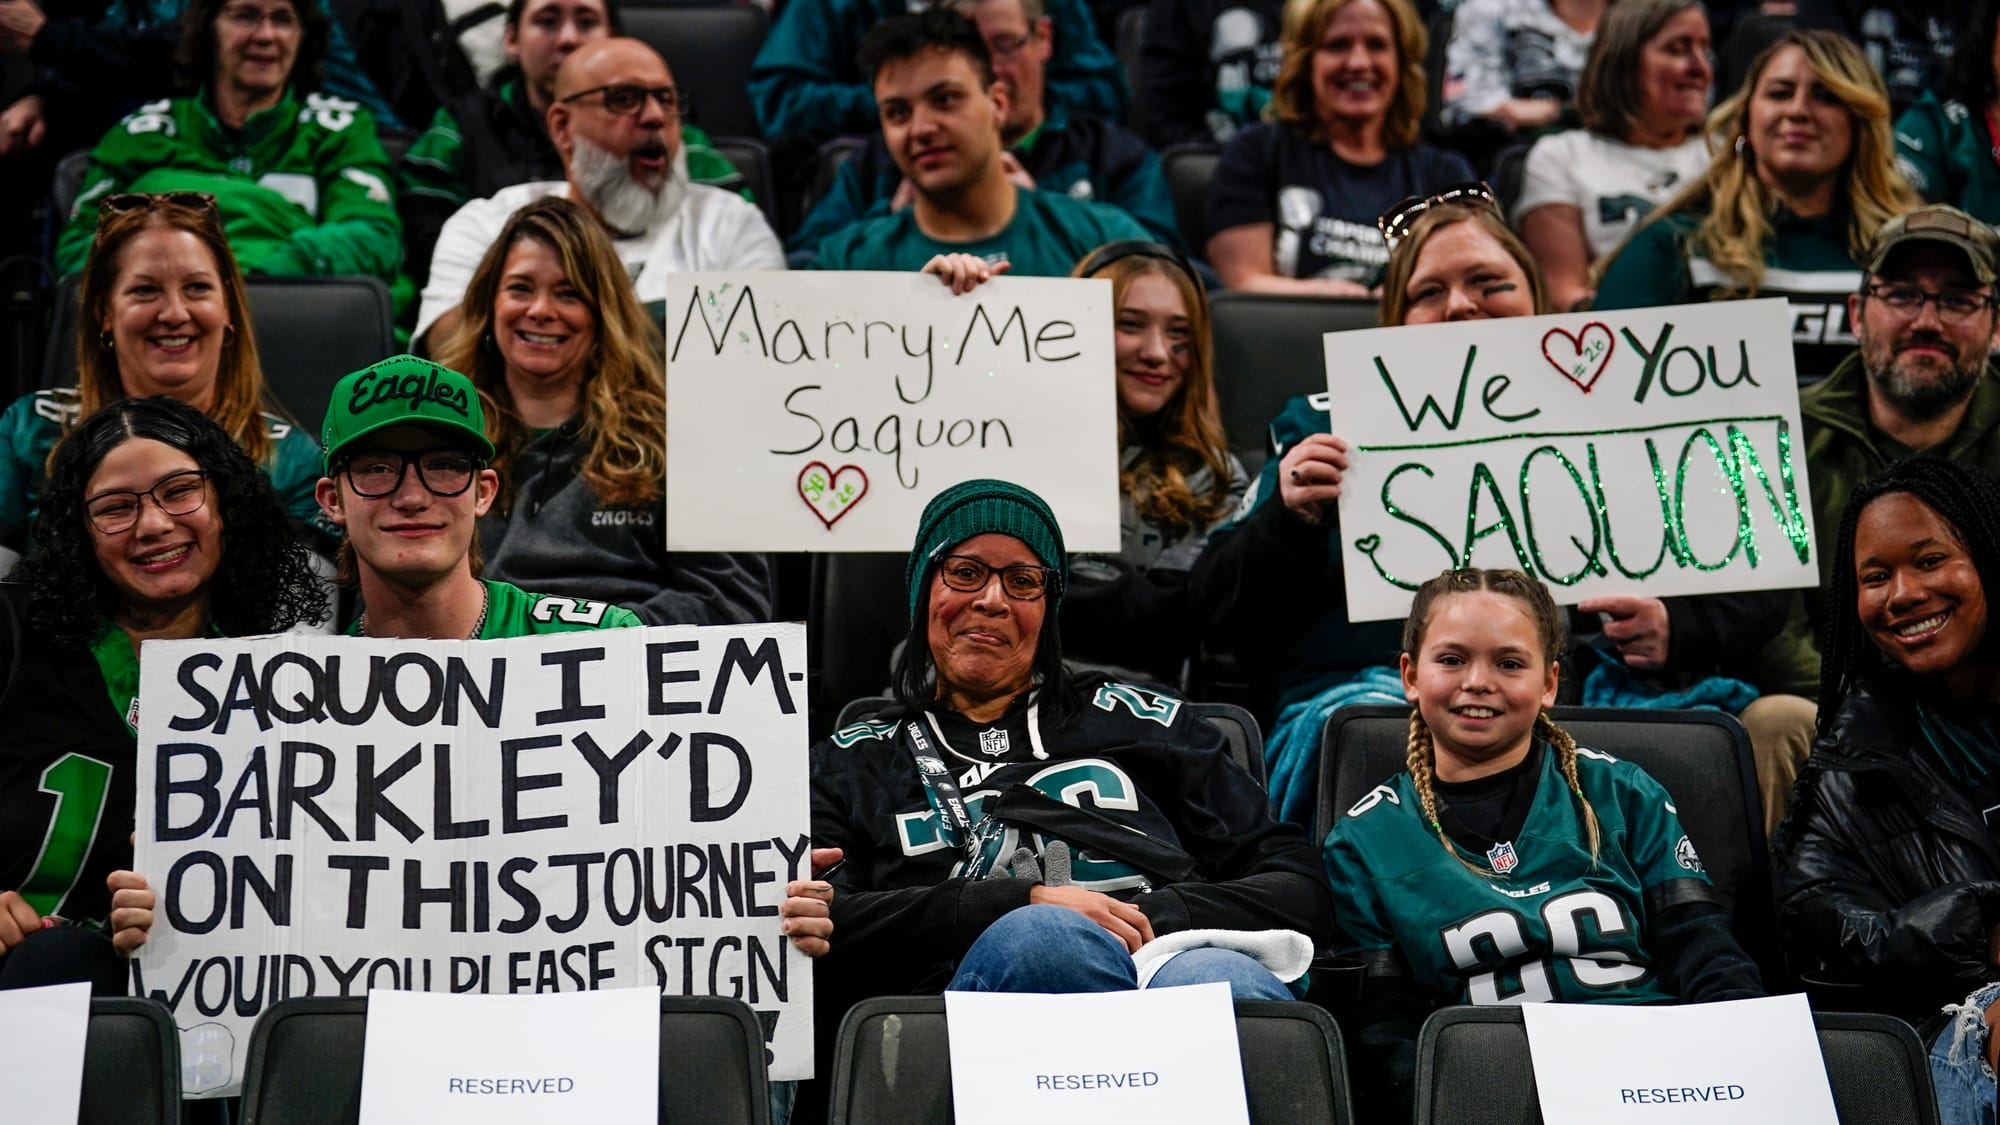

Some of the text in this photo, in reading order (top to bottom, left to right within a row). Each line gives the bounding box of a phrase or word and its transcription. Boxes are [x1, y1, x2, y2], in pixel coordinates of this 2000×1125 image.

[369, 357, 449, 374] PHILADELPHIA
[671, 285, 1082, 405] Marry Me
[1373, 344, 1541, 431] We
[1620, 321, 1761, 404] You
[1572, 340, 1605, 378] #26
[348, 368, 469, 418] Eagles
[769, 385, 1014, 490] Saquon
[1355, 418, 1812, 593] SAQUON
[168, 637, 804, 735] SAQUON I EM-
[907, 720, 929, 751] EAGLES
[154, 730, 753, 844] BARKLEY'D
[164, 850, 294, 936] ON
[644, 934, 788, 1004] SIGN
[448, 1077, 574, 1095] RESERVED
[1035, 1071, 1160, 1090] RESERVED
[1620, 1084, 1746, 1104] RESERVED
